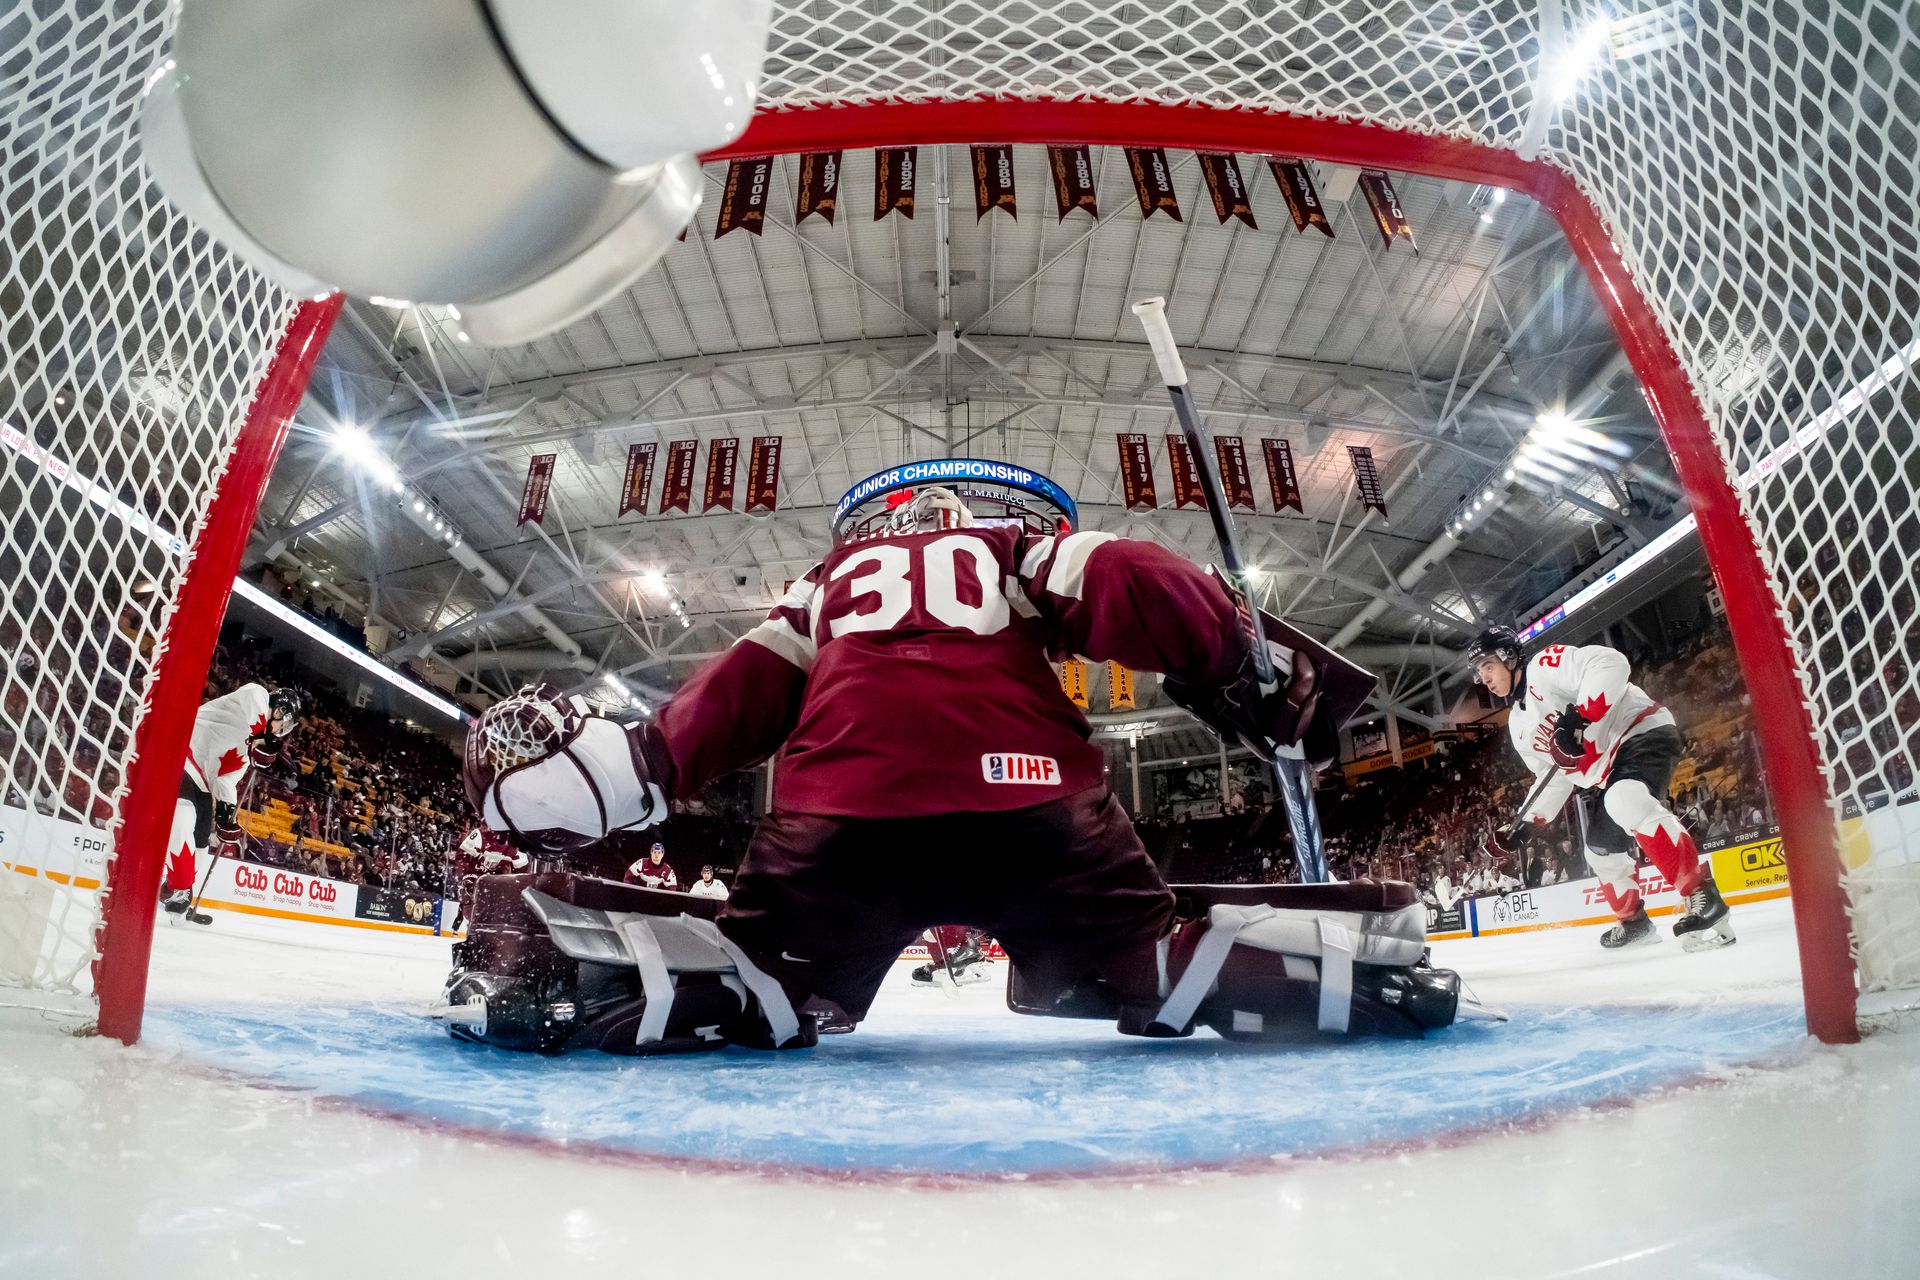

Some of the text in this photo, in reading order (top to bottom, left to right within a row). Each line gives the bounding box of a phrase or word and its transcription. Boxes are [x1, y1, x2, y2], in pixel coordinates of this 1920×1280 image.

[749, 164, 767, 206] 2006
[823, 155, 836, 193] 1997
[900, 152, 913, 191] 1992
[998, 150, 1012, 188] 1989
[1075, 150, 1091, 189] 1988
[1152, 152, 1169, 192] 1983
[1224, 159, 1241, 199] 1981
[1380, 180, 1404, 219] 1970
[680, 451, 692, 487] 2025
[723, 450, 734, 485] 2023
[765, 448, 777, 484] 2022
[1136, 446, 1148, 482] 2017
[1279, 451, 1294, 487] 2014
[851, 471, 901, 503] JUNIOR
[903, 463, 1033, 485] CHAMPIONSHIP
[962, 489, 973, 497] at
[974, 489, 1027, 507] MARIUCCI
[829, 534, 1010, 639] 30
[1529, 685, 1543, 702] C
[1532, 711, 1559, 753] CANAD
[1007, 757, 1054, 780] IIHF
[1401, 744, 1433, 760] HOCKEY
[234, 888, 266, 901] Shop happy
[235, 865, 268, 891] Cub
[274, 873, 304, 897] Cub
[309, 880, 337, 902] Cub
[1745, 876, 1772, 887] Service,
[1512, 892, 1539, 913] BFL
[1513, 911, 1539, 922] CANADA
